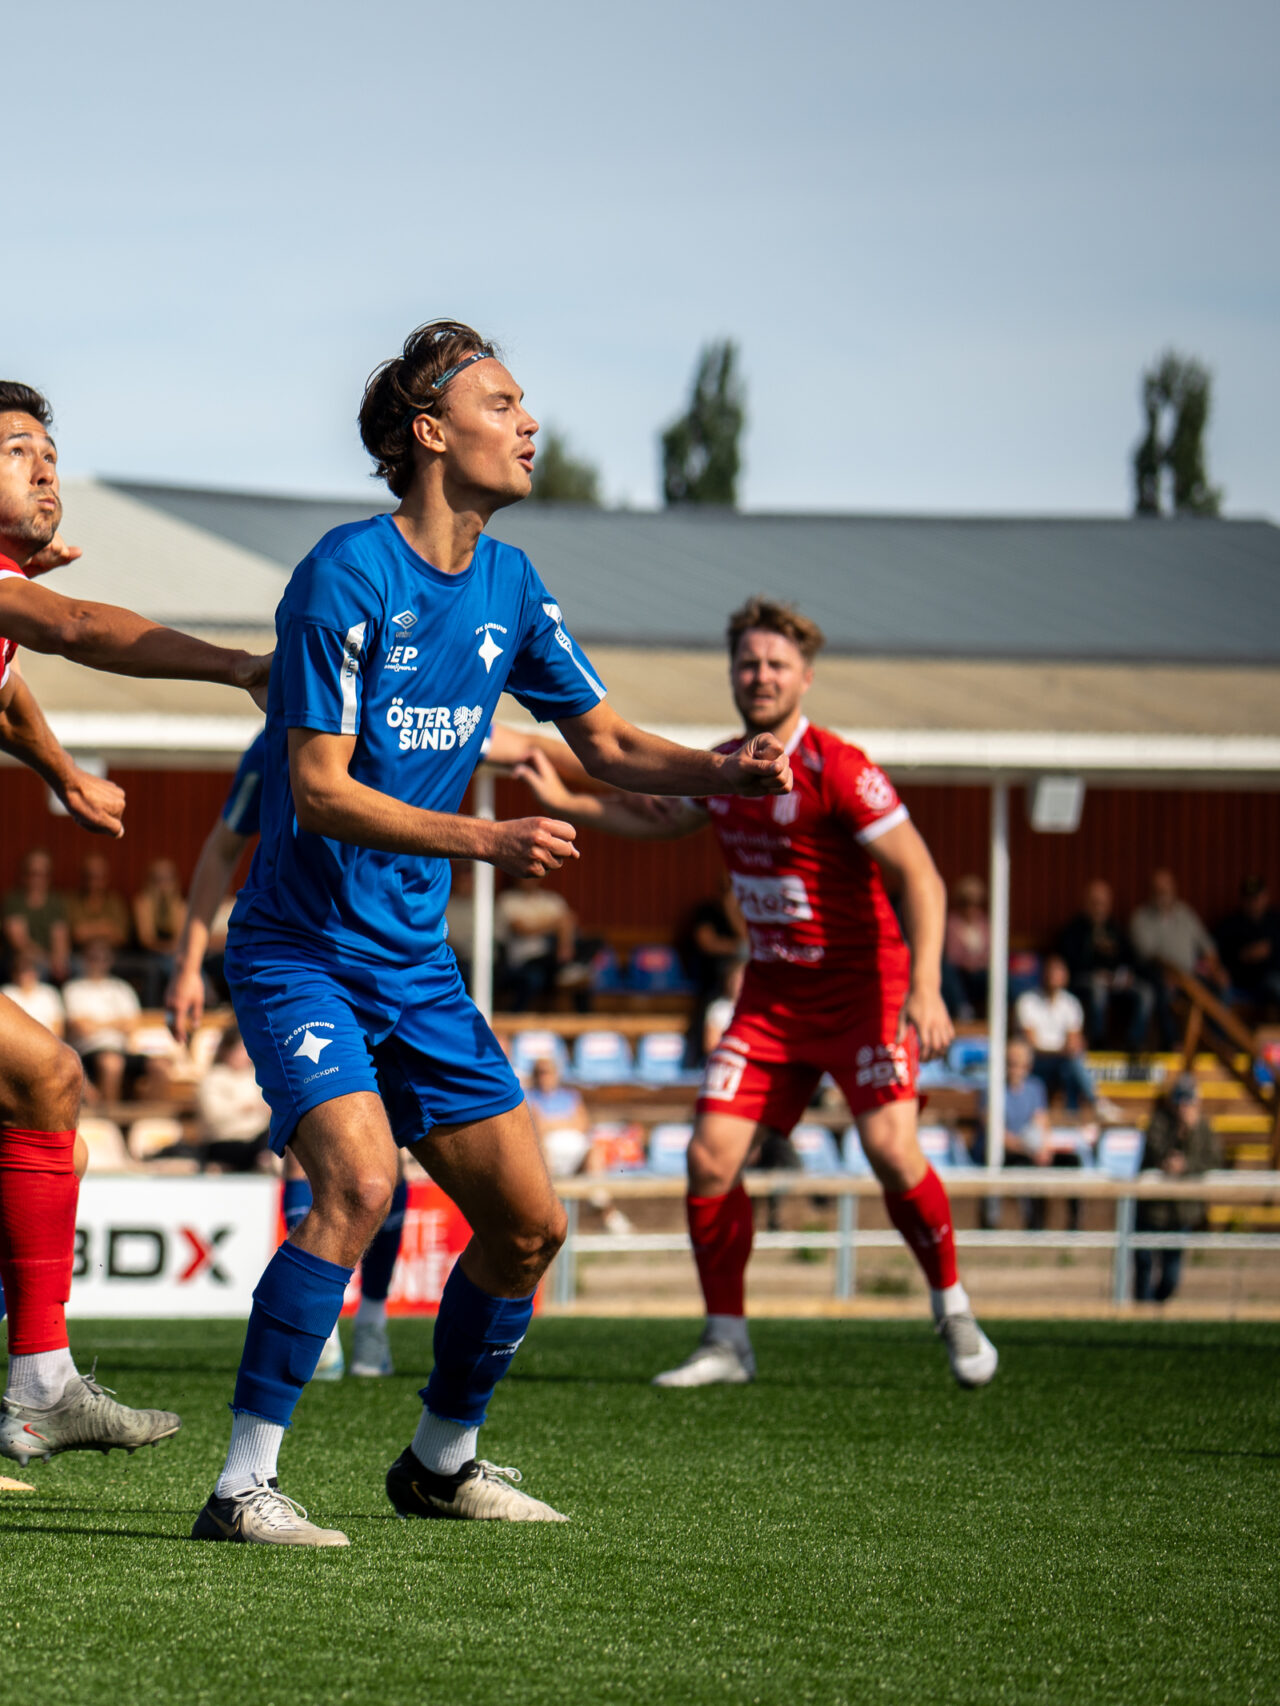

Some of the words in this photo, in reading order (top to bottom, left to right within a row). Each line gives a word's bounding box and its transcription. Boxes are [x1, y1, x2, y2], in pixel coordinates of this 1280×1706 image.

[386, 697, 451, 729] ÖSTER
[398, 728, 457, 751] SUND
[283, 1035, 294, 1047] IFK
[303, 1065, 339, 1084] QUICKDRY
